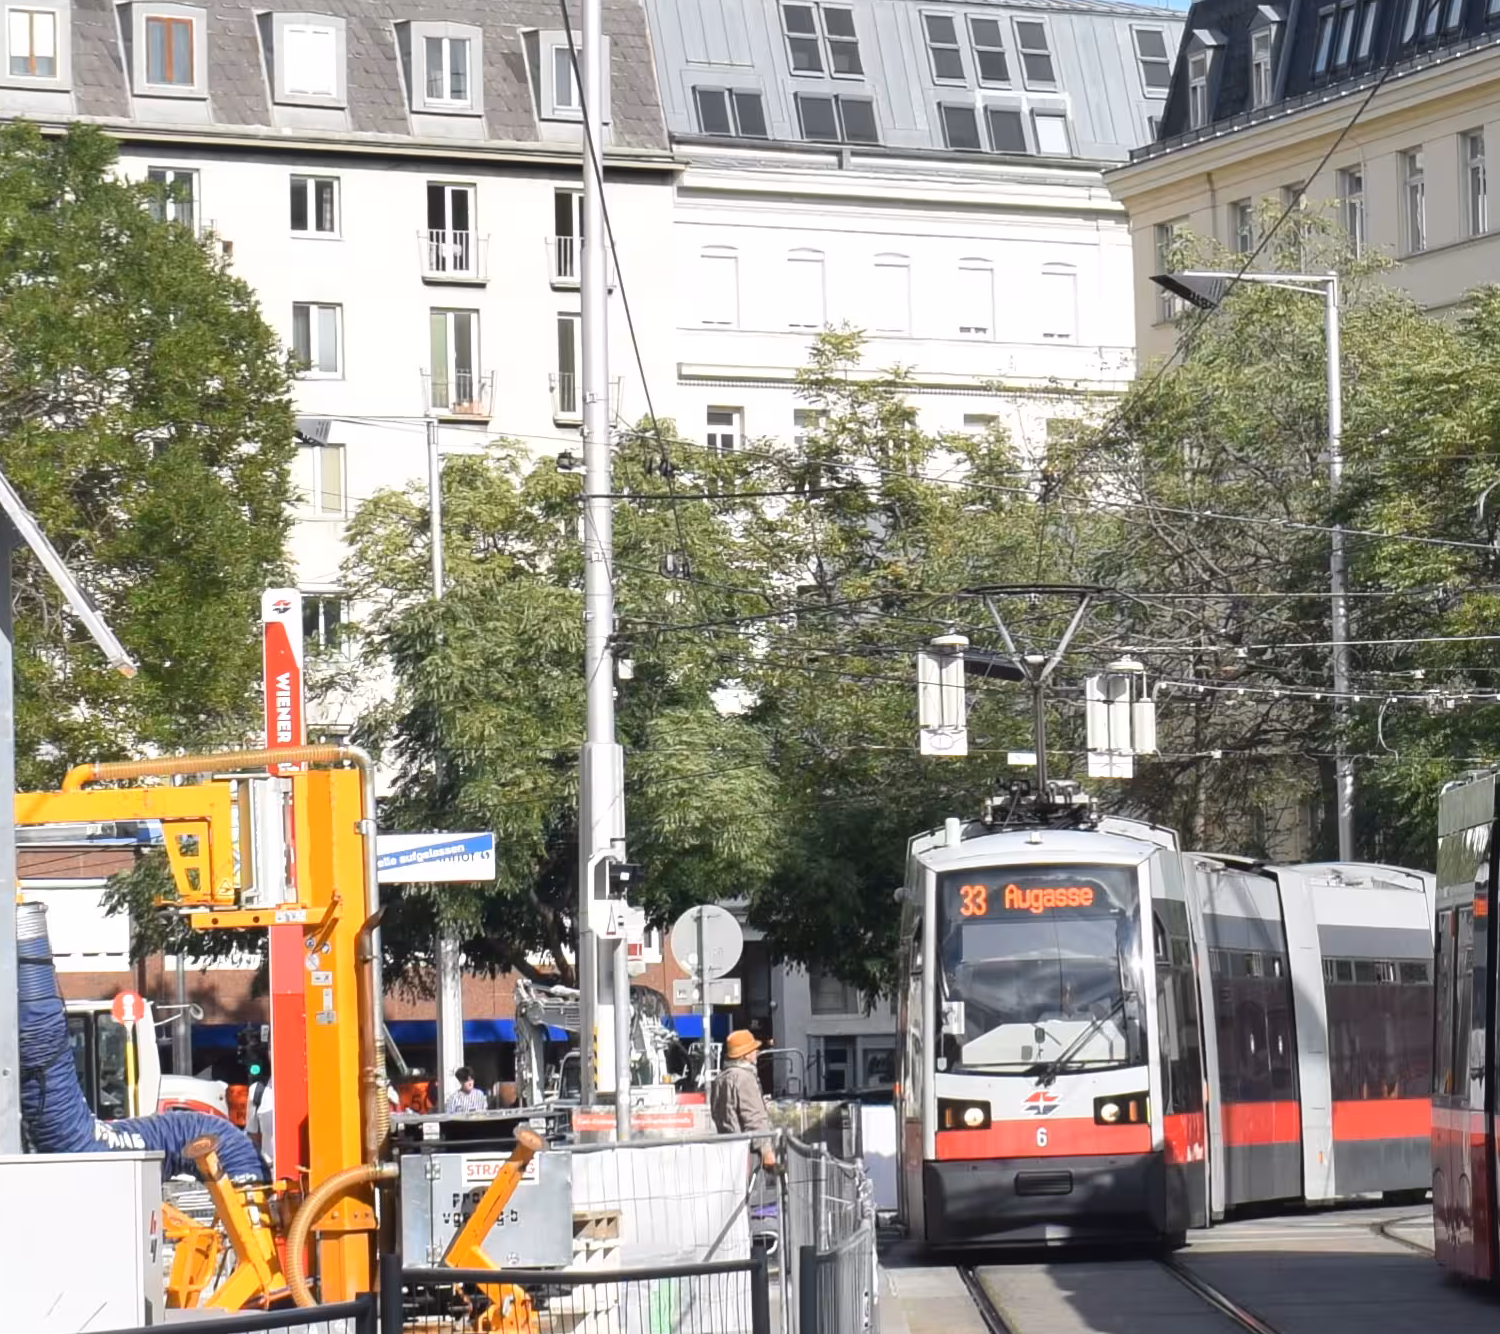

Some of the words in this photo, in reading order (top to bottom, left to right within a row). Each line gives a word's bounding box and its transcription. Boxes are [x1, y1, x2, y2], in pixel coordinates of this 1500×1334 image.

[275, 672, 293, 744] WIENER
[376, 856, 397, 869] elle
[959, 884, 988, 917] 33
[1004, 883, 1094, 915] Augasse
[1035, 1126, 1049, 1148] 6
[466, 1162, 536, 1177] STRAG
